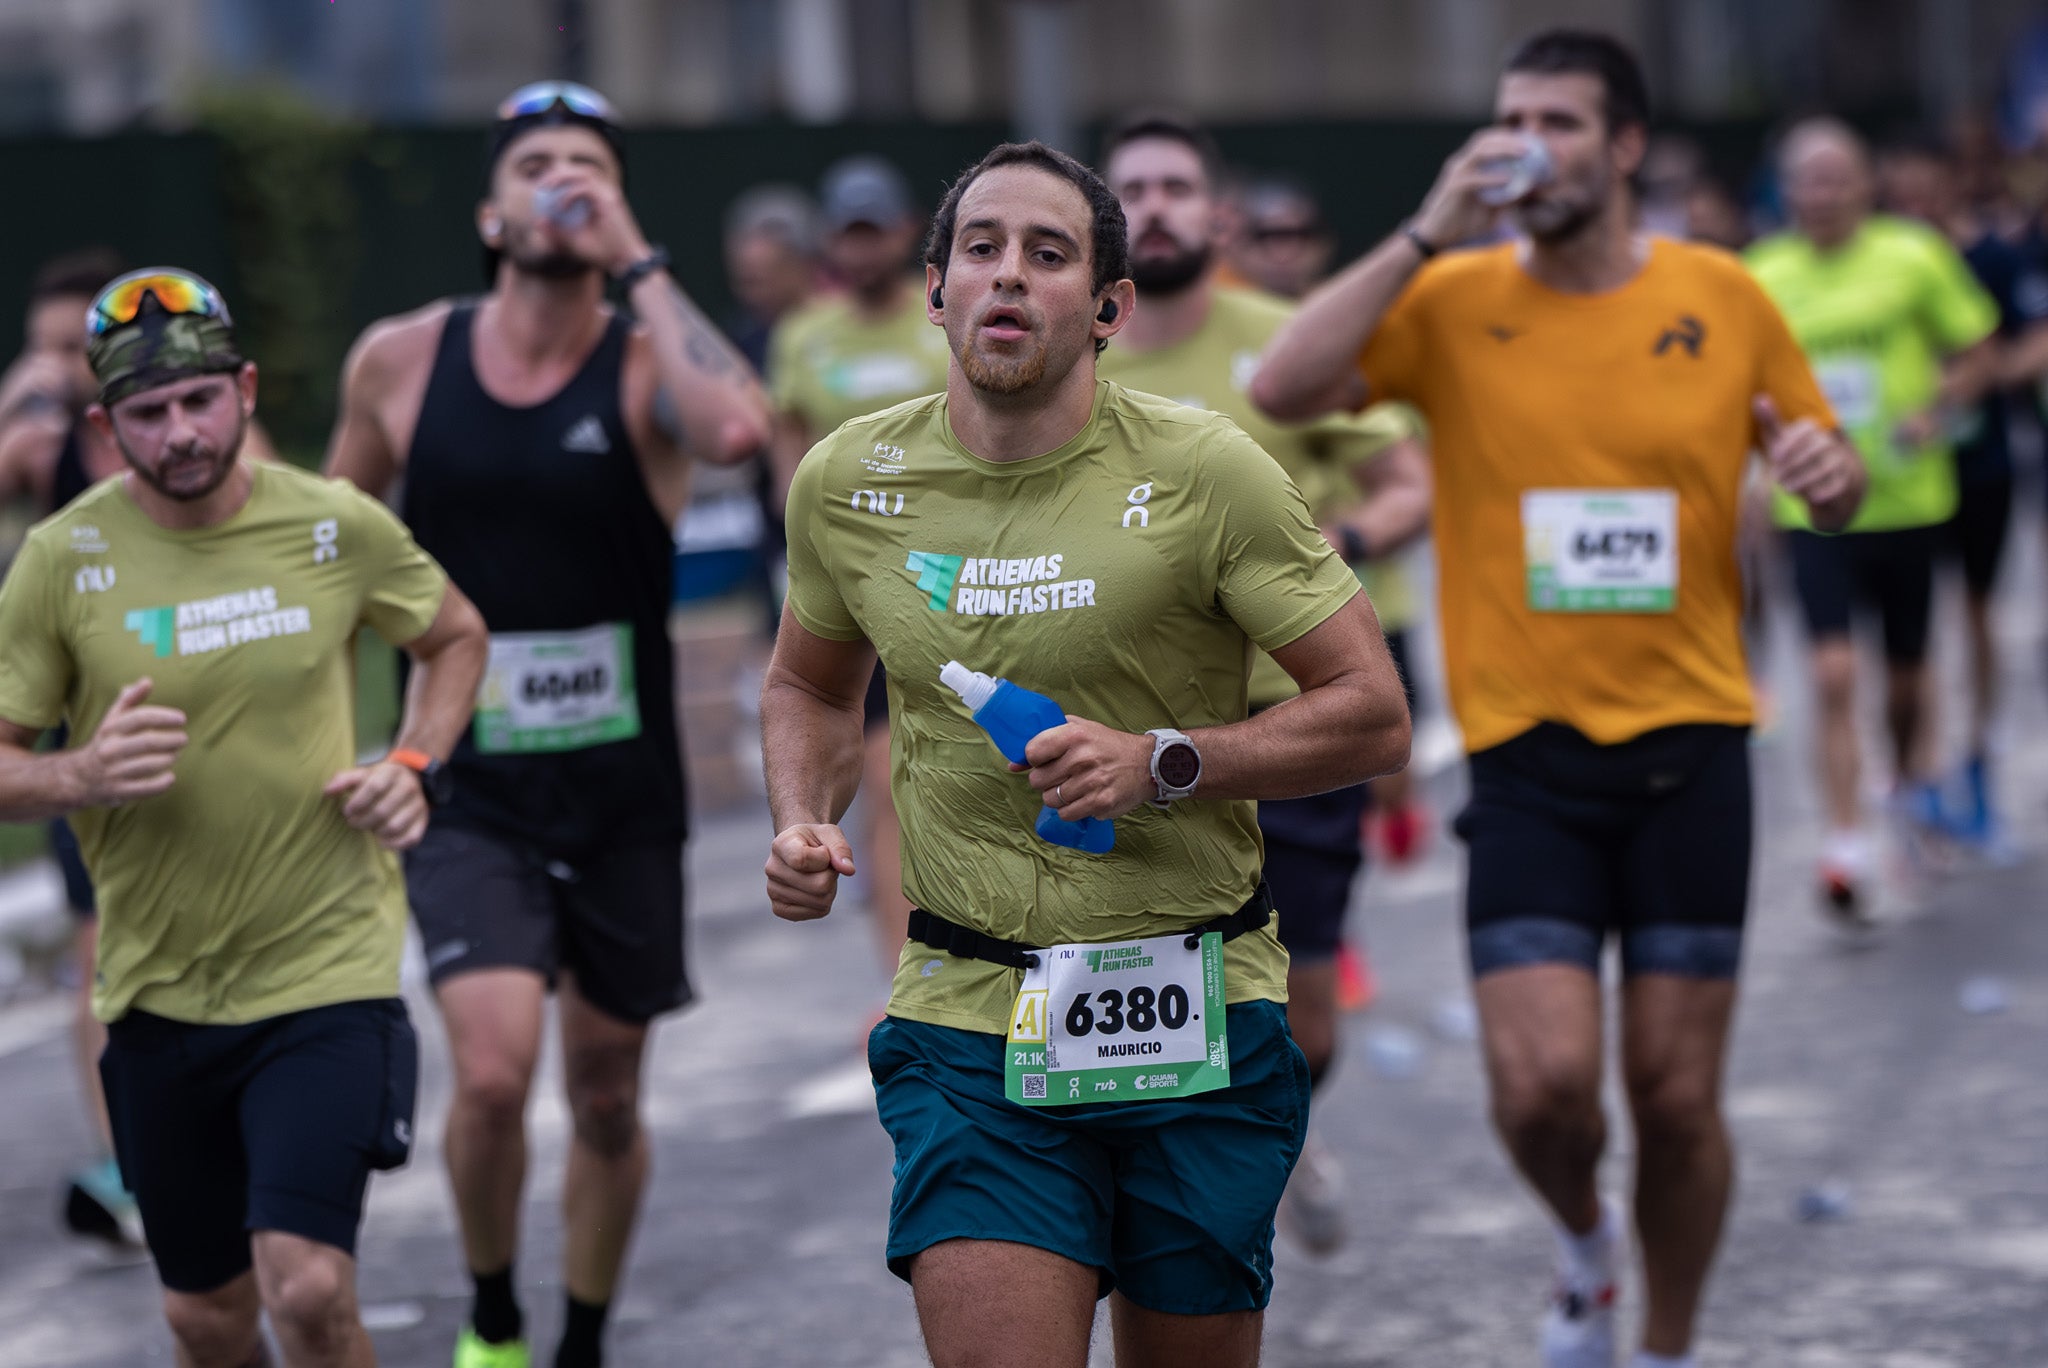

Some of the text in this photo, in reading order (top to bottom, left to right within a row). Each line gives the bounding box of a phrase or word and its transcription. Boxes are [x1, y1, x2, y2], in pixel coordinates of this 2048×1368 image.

[959, 553, 1064, 586] ATHENAS
[176, 585, 278, 631] ATHENAS
[956, 578, 1096, 616] RUN FASTER
[177, 605, 311, 656] RUN FASTER
[1102, 956, 1154, 972] RUN FASTER
[1103, 946, 1142, 960] ATHENAS
[1018, 997, 1038, 1035] A
[1065, 984, 1189, 1037] 6380
[1014, 1051, 1046, 1066] 21.1K
[1097, 1041, 1162, 1058] MAURICIO
[1209, 1041, 1221, 1067] 6380
[1148, 1080, 1178, 1089] SPORTS
[1149, 1073, 1178, 1082] IGUANA
